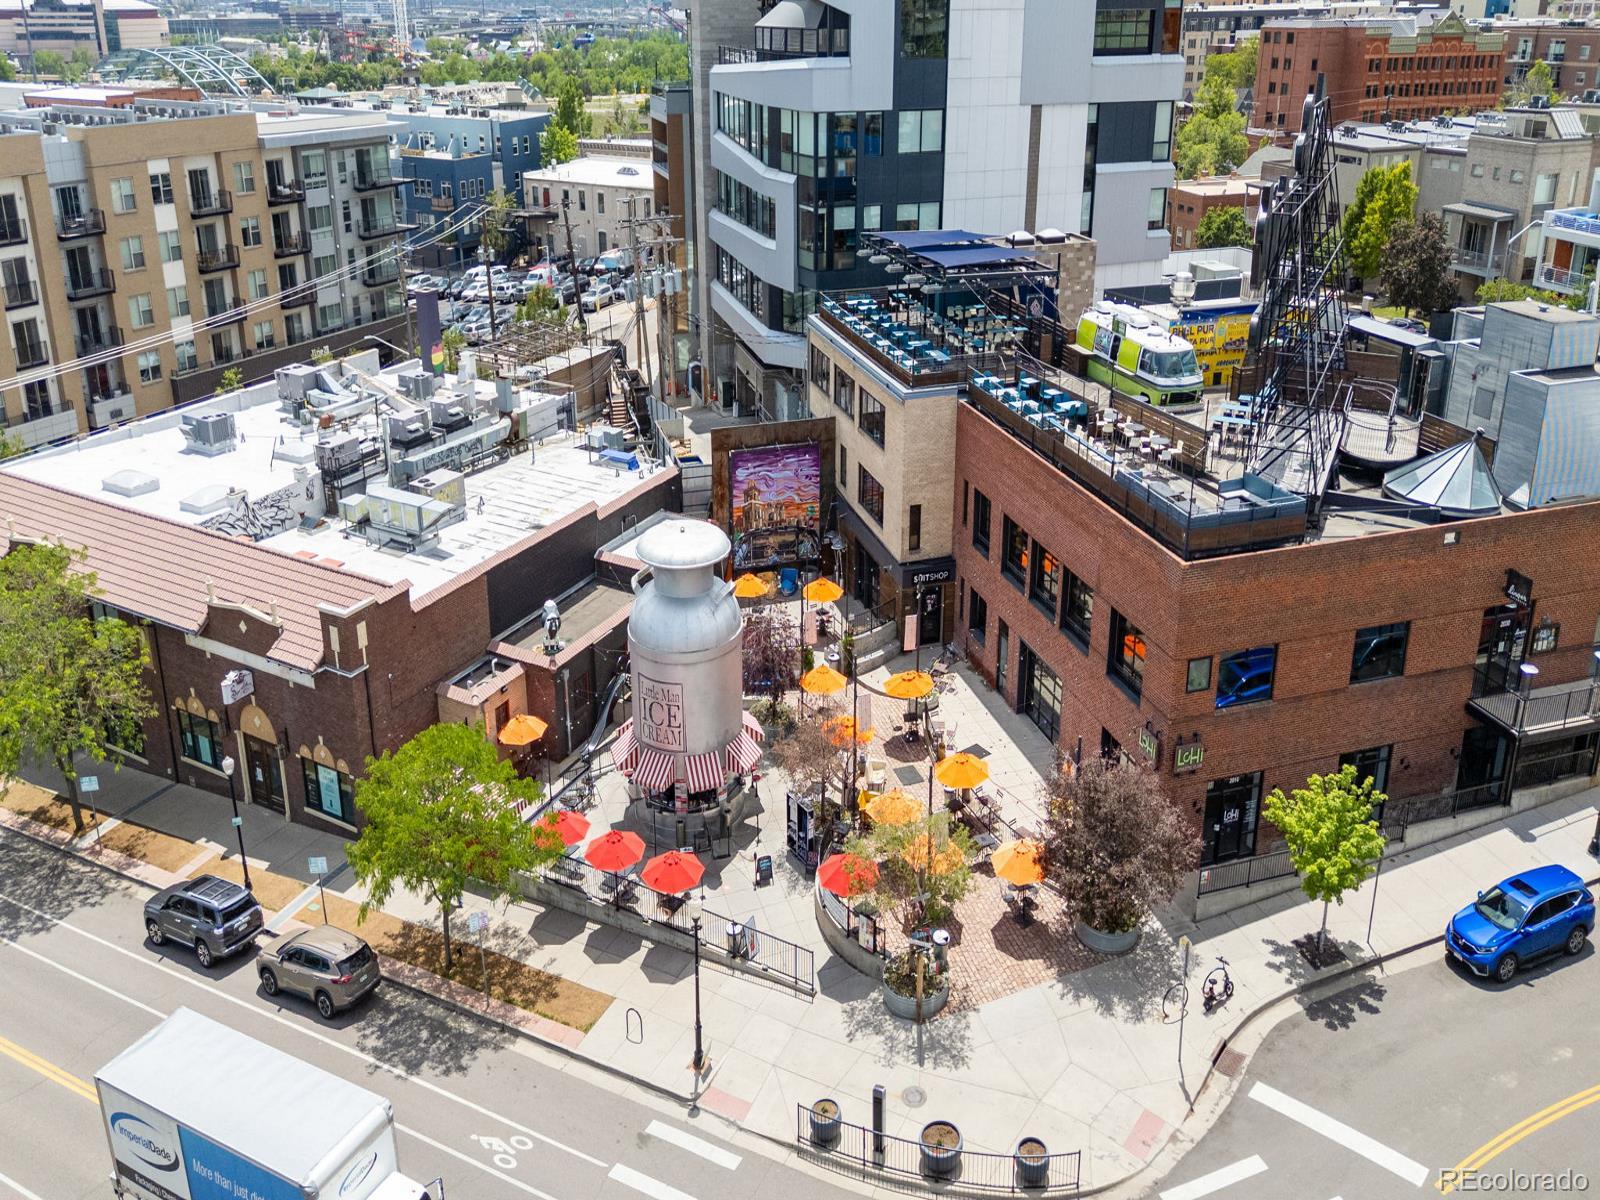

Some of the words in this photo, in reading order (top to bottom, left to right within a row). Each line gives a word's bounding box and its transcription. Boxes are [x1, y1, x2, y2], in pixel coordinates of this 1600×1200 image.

[641, 681, 660, 700] Little
[661, 688, 680, 704] Man
[642, 697, 682, 729] ICE
[642, 723, 682, 746] CREAM
[118, 1122, 172, 1161] ImperialDade
[192, 1159, 213, 1181] More
[214, 1171, 232, 1191] than
[233, 1179, 249, 1200] just
